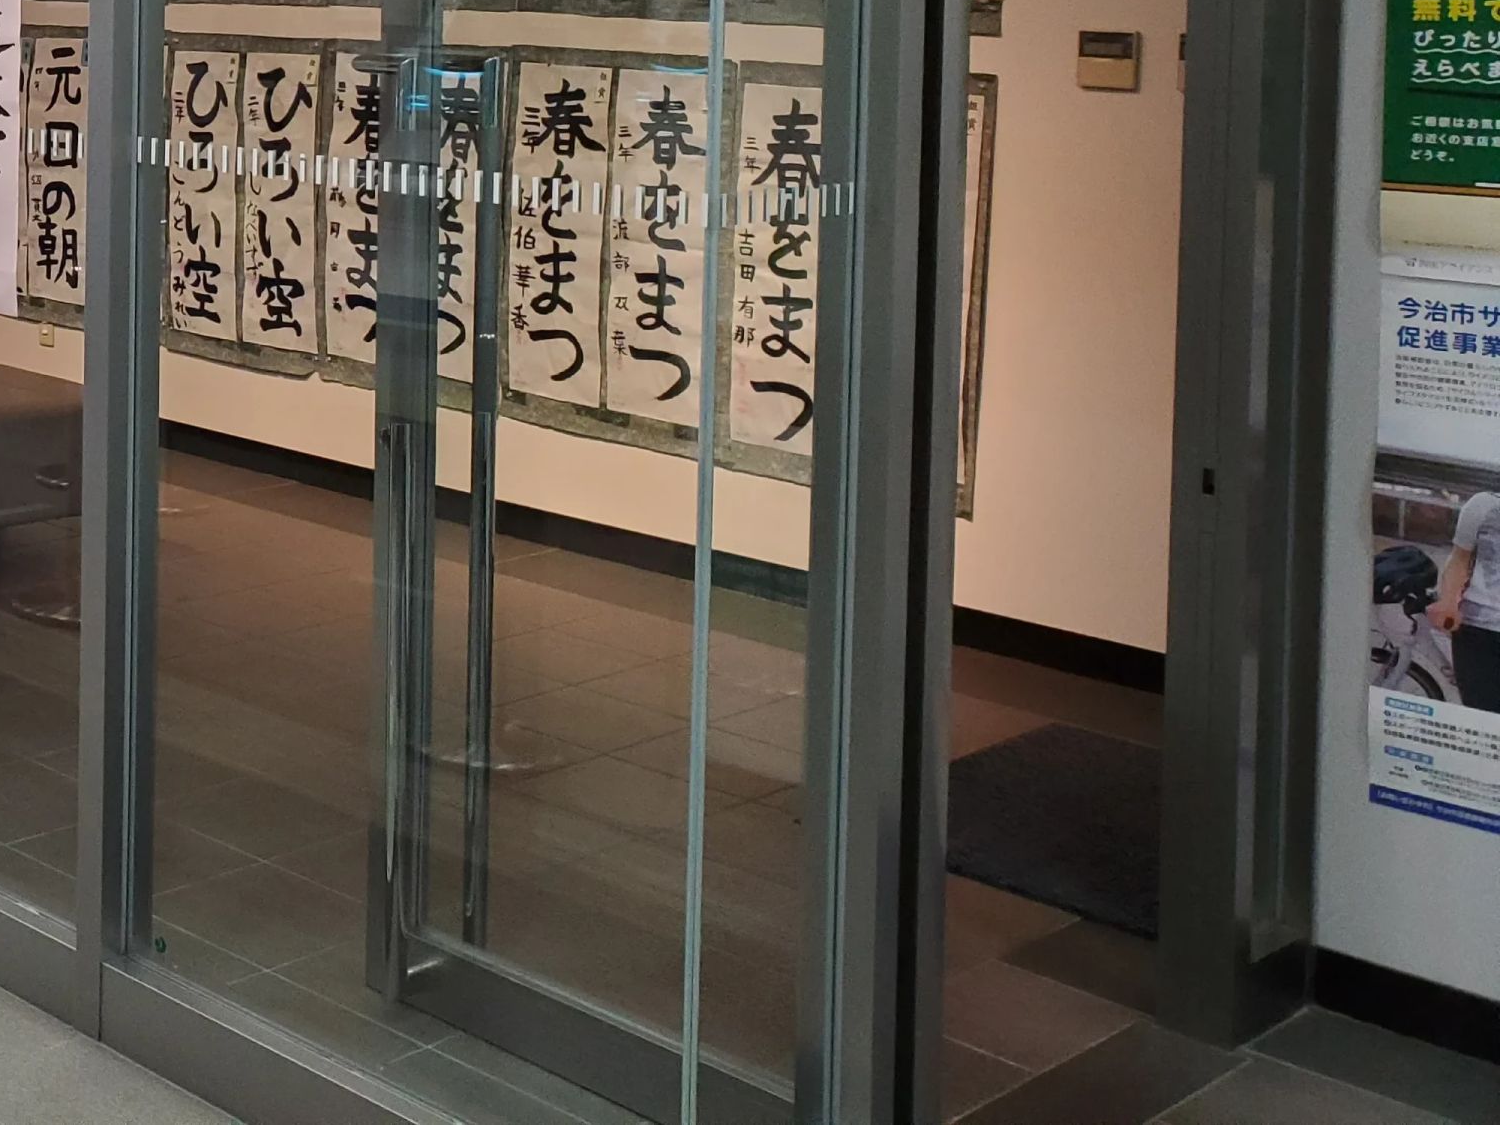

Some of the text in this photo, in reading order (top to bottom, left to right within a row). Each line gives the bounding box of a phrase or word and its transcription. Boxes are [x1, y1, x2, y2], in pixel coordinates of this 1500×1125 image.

[36, 46, 82, 290] 元日の朝
[183, 61, 229, 324] ひろい空
[255, 66, 313, 337] ひろい空
[527, 78, 607, 382] 春をまつ
[629, 84, 707, 402] 春をまつ
[749, 98, 821, 442] 春をまつ
[1396, 324, 1500, 358] 促進事業
